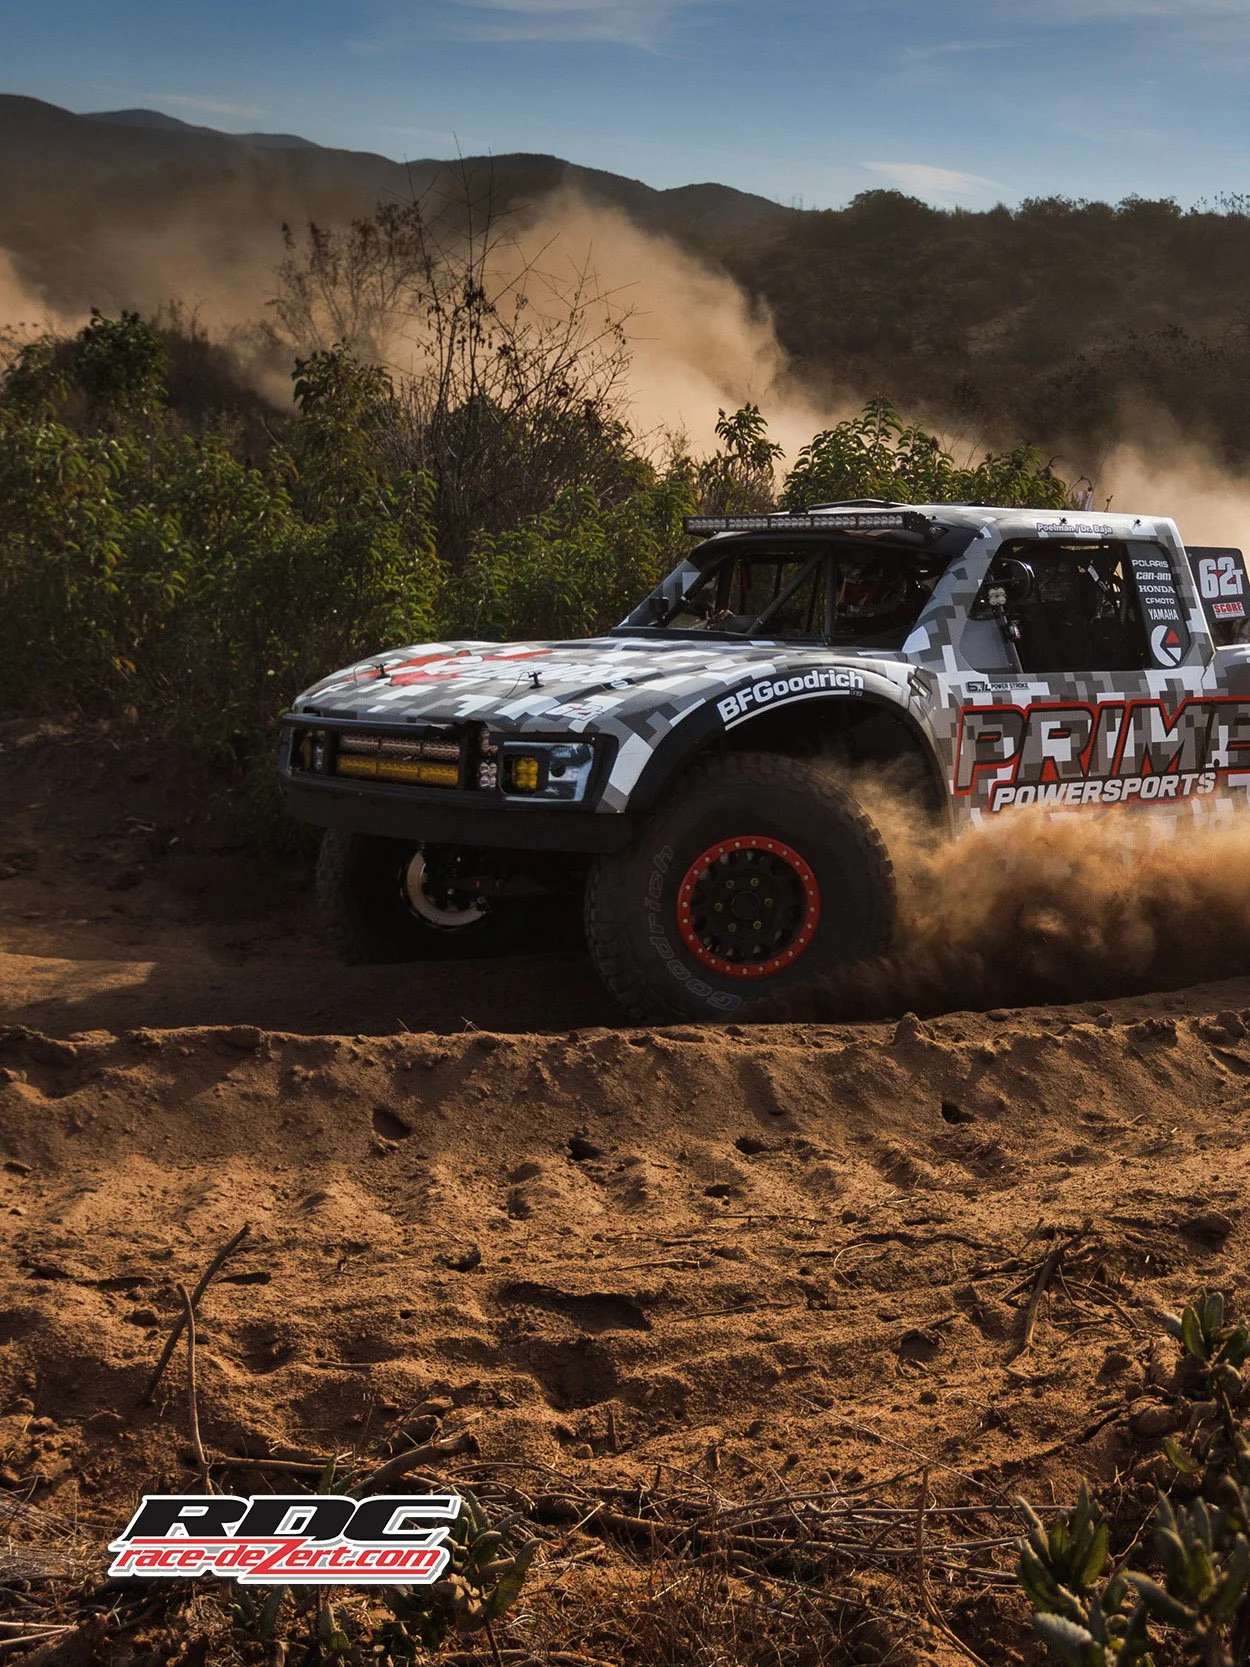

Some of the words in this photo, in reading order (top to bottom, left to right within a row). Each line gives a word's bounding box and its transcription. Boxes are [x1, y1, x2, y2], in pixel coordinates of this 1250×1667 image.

[1036, 523, 1076, 533] Poelman
[1093, 525, 1113, 536] Baja
[1132, 559, 1169, 568] POLARIS
[1199, 556, 1244, 599] 62T
[1138, 585, 1176, 594] HONDA
[1145, 597, 1175, 605] CFMOTO
[1148, 608, 1179, 620] YAMAHA
[1213, 602, 1243, 614] SCORE
[716, 669, 864, 723] BFGoodrich
[992, 772, 1217, 812] POWERSPORTS
